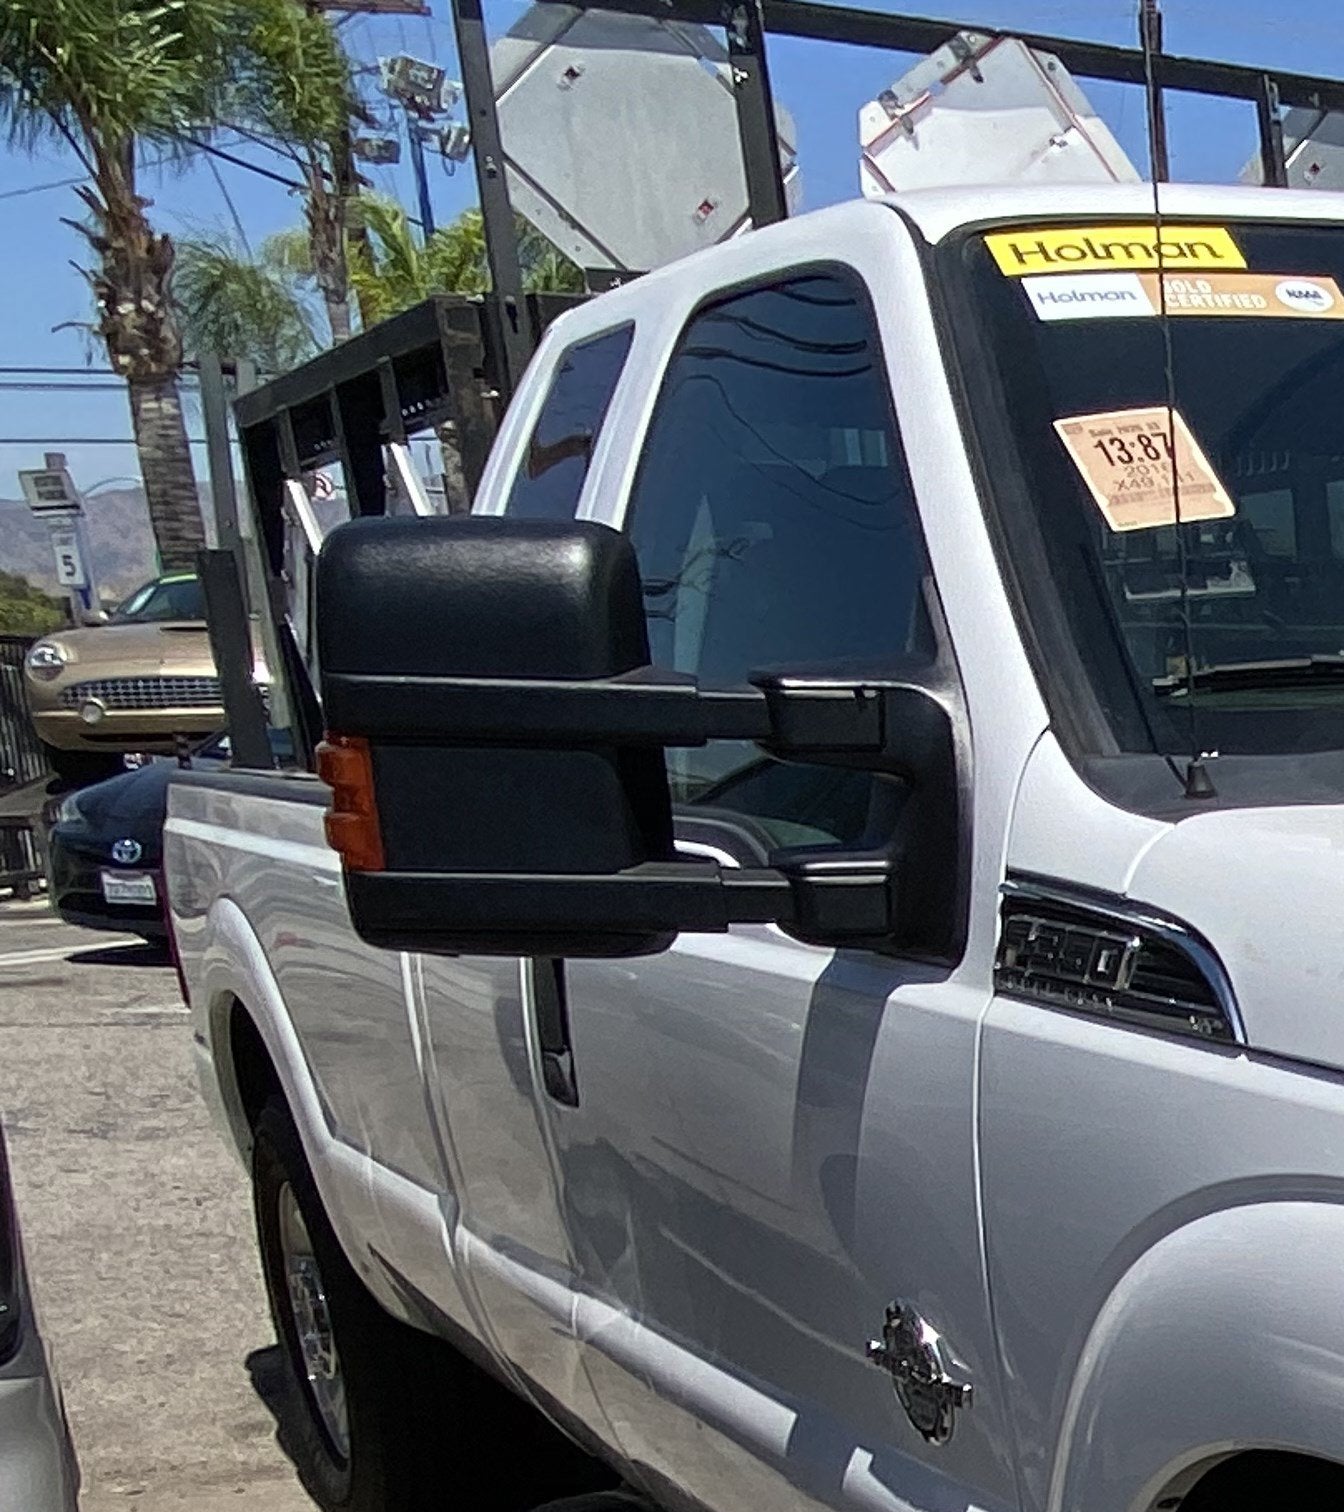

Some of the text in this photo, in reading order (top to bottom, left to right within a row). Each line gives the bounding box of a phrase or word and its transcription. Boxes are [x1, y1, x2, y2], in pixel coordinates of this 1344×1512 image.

[1008, 237, 1224, 265] Holman
[1036, 289, 1137, 305] Holman
[1164, 293, 1267, 309] CERTIFIED
[61, 553, 76, 577] 5
